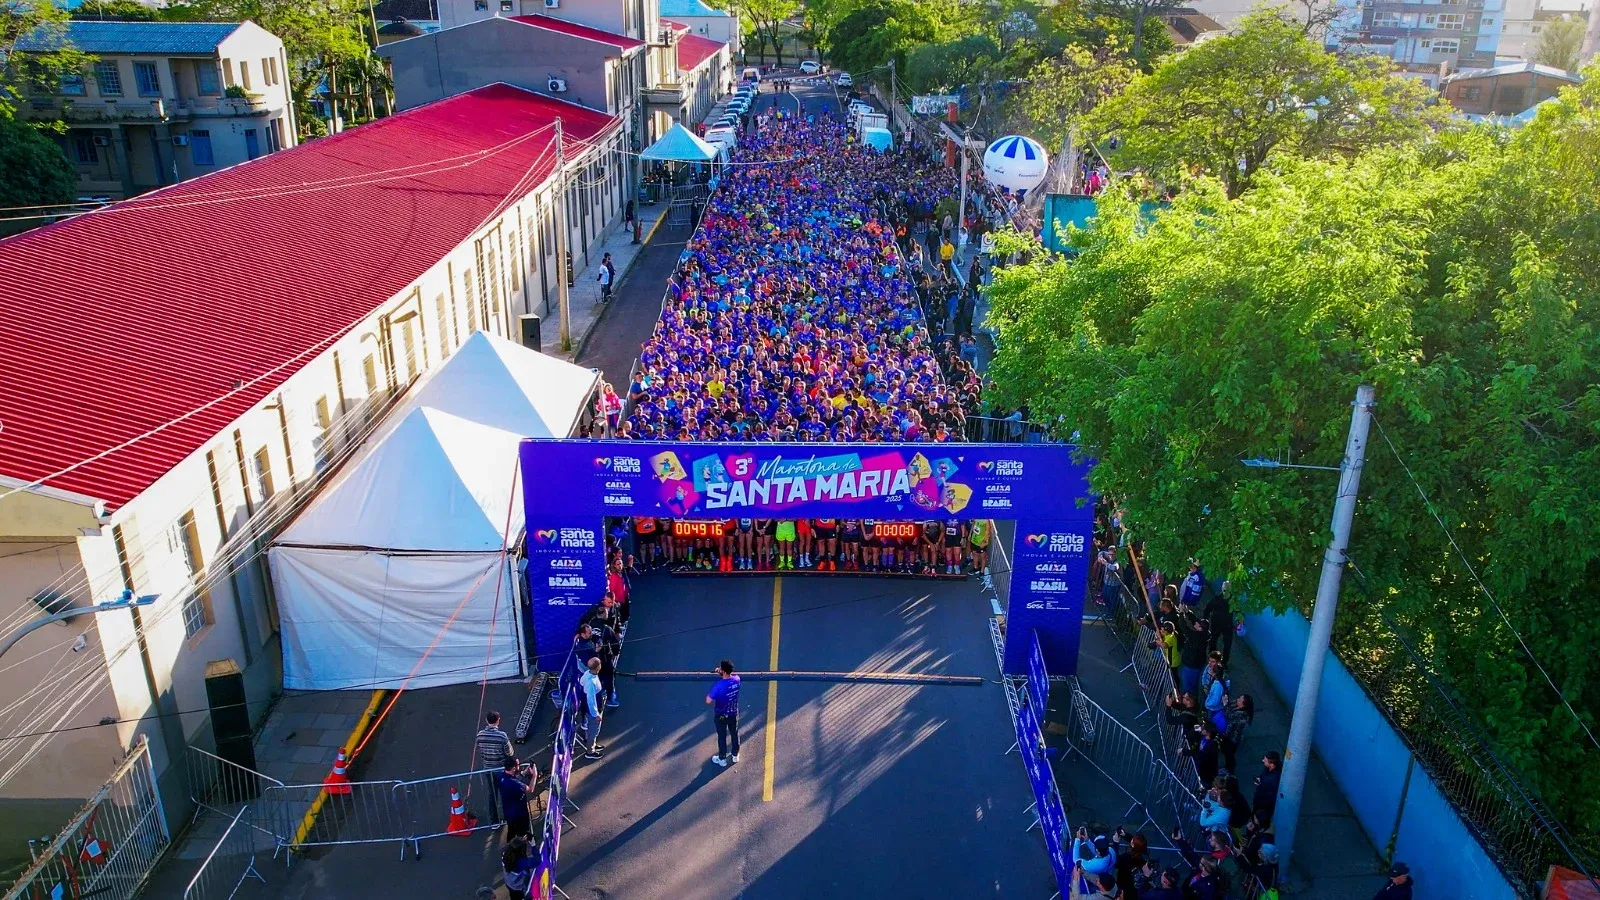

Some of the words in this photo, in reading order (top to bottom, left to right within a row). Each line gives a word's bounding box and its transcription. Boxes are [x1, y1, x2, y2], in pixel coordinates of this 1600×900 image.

[613, 457, 641, 466] santa
[997, 461, 1024, 469] santa
[613, 465, 641, 473] maria
[756, 455, 840, 484] Maratona
[996, 468, 1023, 476] maria
[706, 475, 808, 509] SANTA
[814, 468, 911, 501] MARIA
[604, 496, 634, 504] BRASIL
[885, 494, 902, 503] 2025
[983, 499, 1012, 507] BRASIL
[560, 529, 595, 539] santa
[560, 539, 595, 548] maria
[1050, 534, 1085, 544] santa
[1049, 543, 1084, 552] maria
[550, 559, 582, 567] CAIXA
[1035, 564, 1067, 572] CAIXA
[548, 577, 587, 587] BRASIL
[1030, 581, 1068, 591] BRASIL
